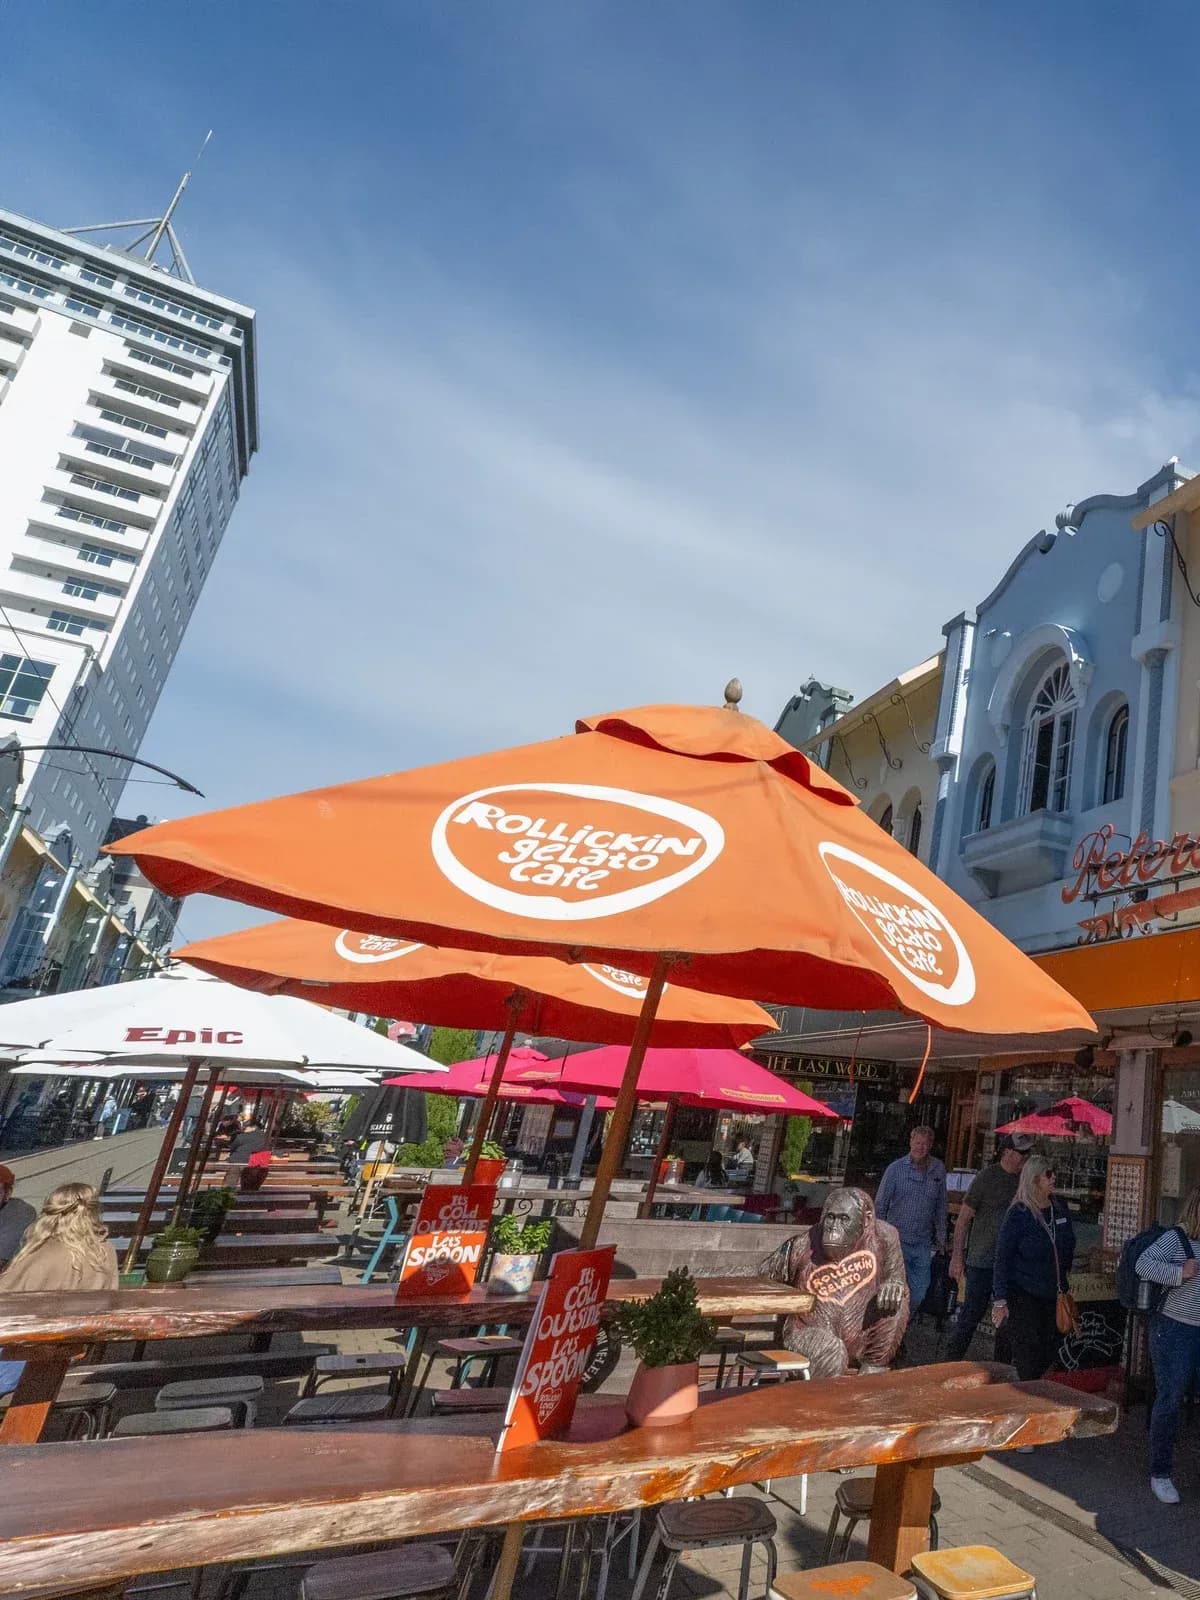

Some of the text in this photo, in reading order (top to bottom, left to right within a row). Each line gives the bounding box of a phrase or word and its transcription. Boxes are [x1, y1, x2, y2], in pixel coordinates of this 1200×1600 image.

[510, 861, 609, 890] cafe
[124, 1027, 243, 1045] Epic
[798, 1058, 833, 1074] LAST
[406, 1244, 481, 1267] SPOON
[818, 1272, 861, 1297] GELATO
[520, 1343, 593, 1403] SPOON
